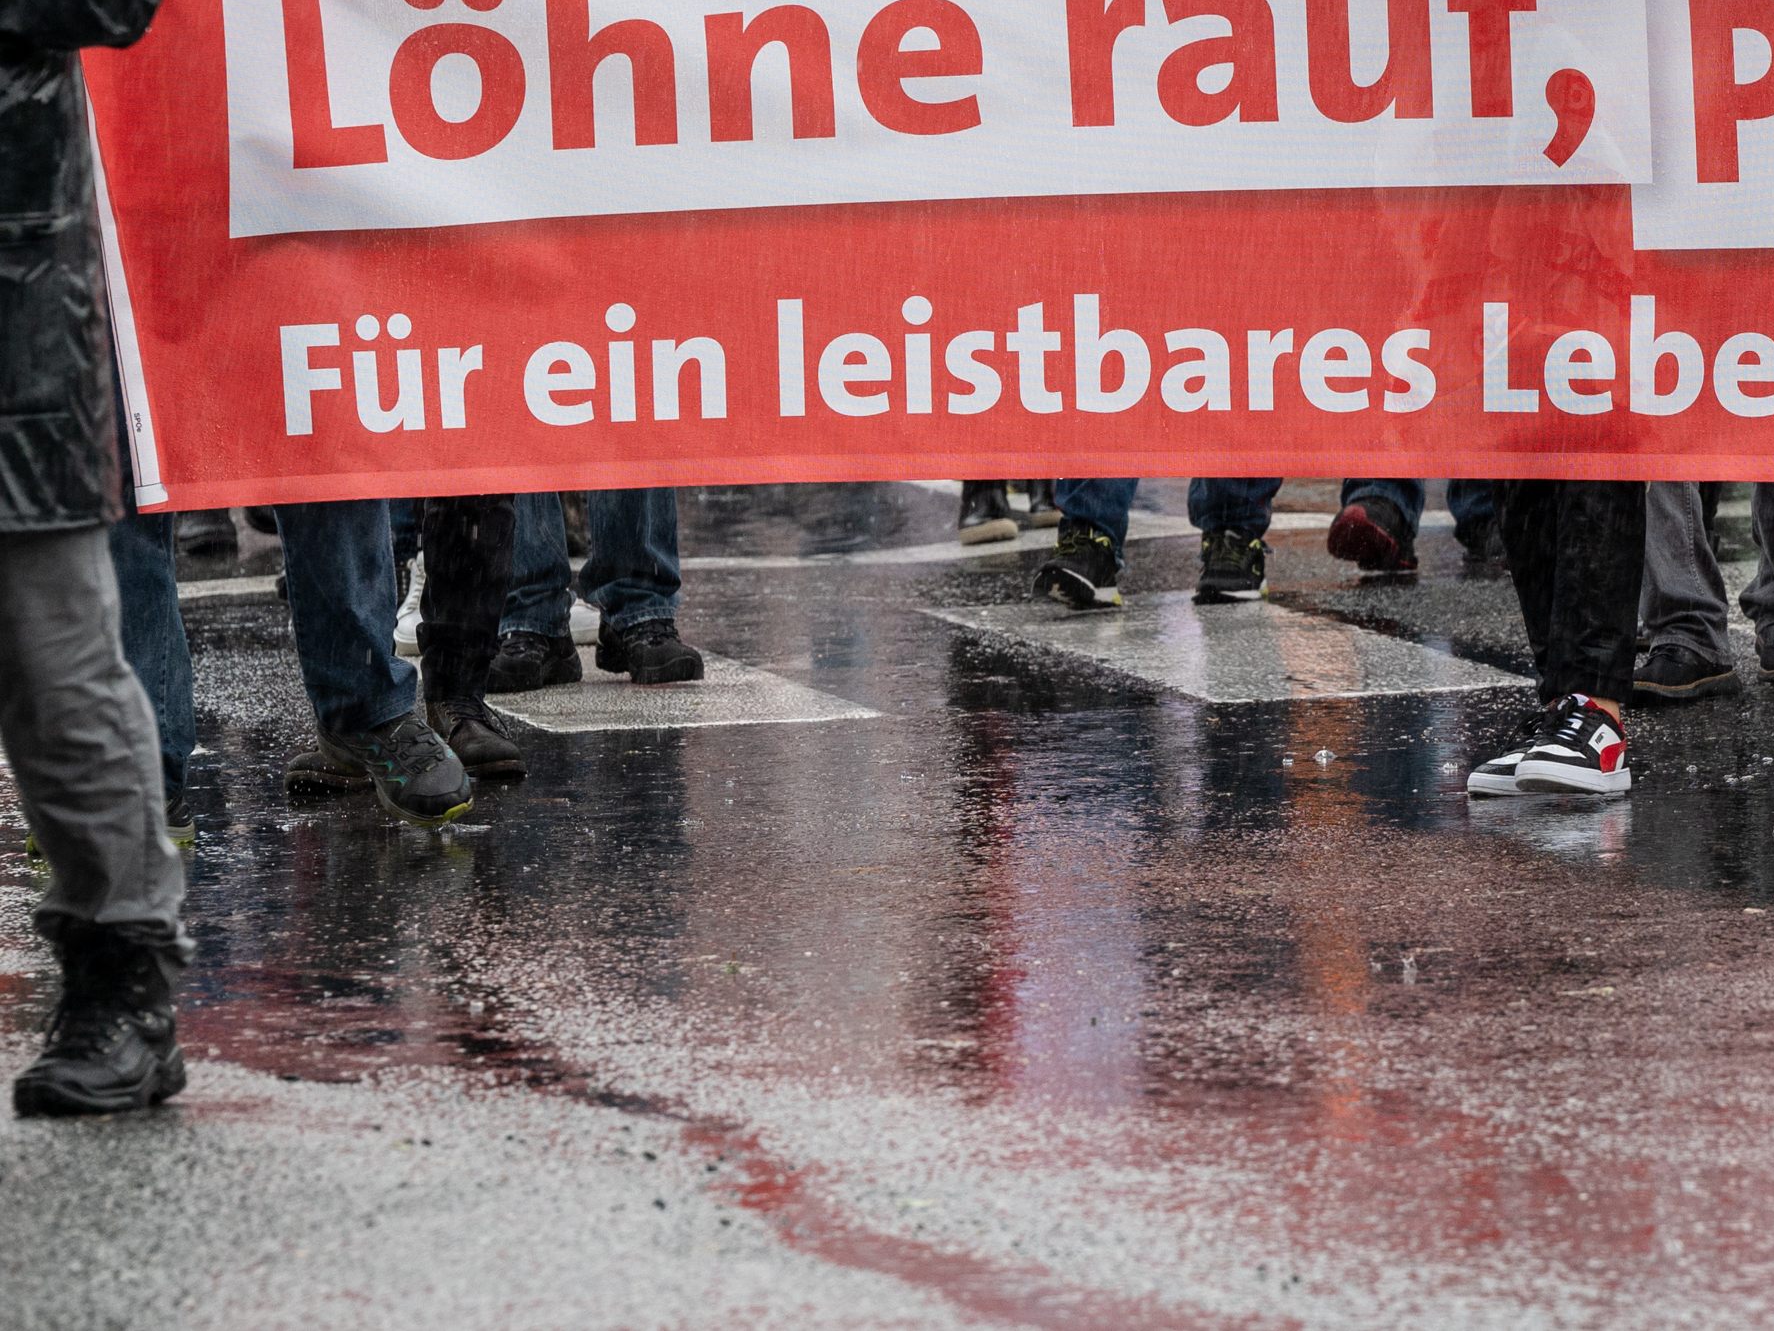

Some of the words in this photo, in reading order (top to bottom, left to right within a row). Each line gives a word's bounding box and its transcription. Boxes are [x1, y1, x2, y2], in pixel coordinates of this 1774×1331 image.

[279, 311, 484, 437] Für
[522, 301, 728, 427] ein
[777, 292, 1438, 421] leistbares
